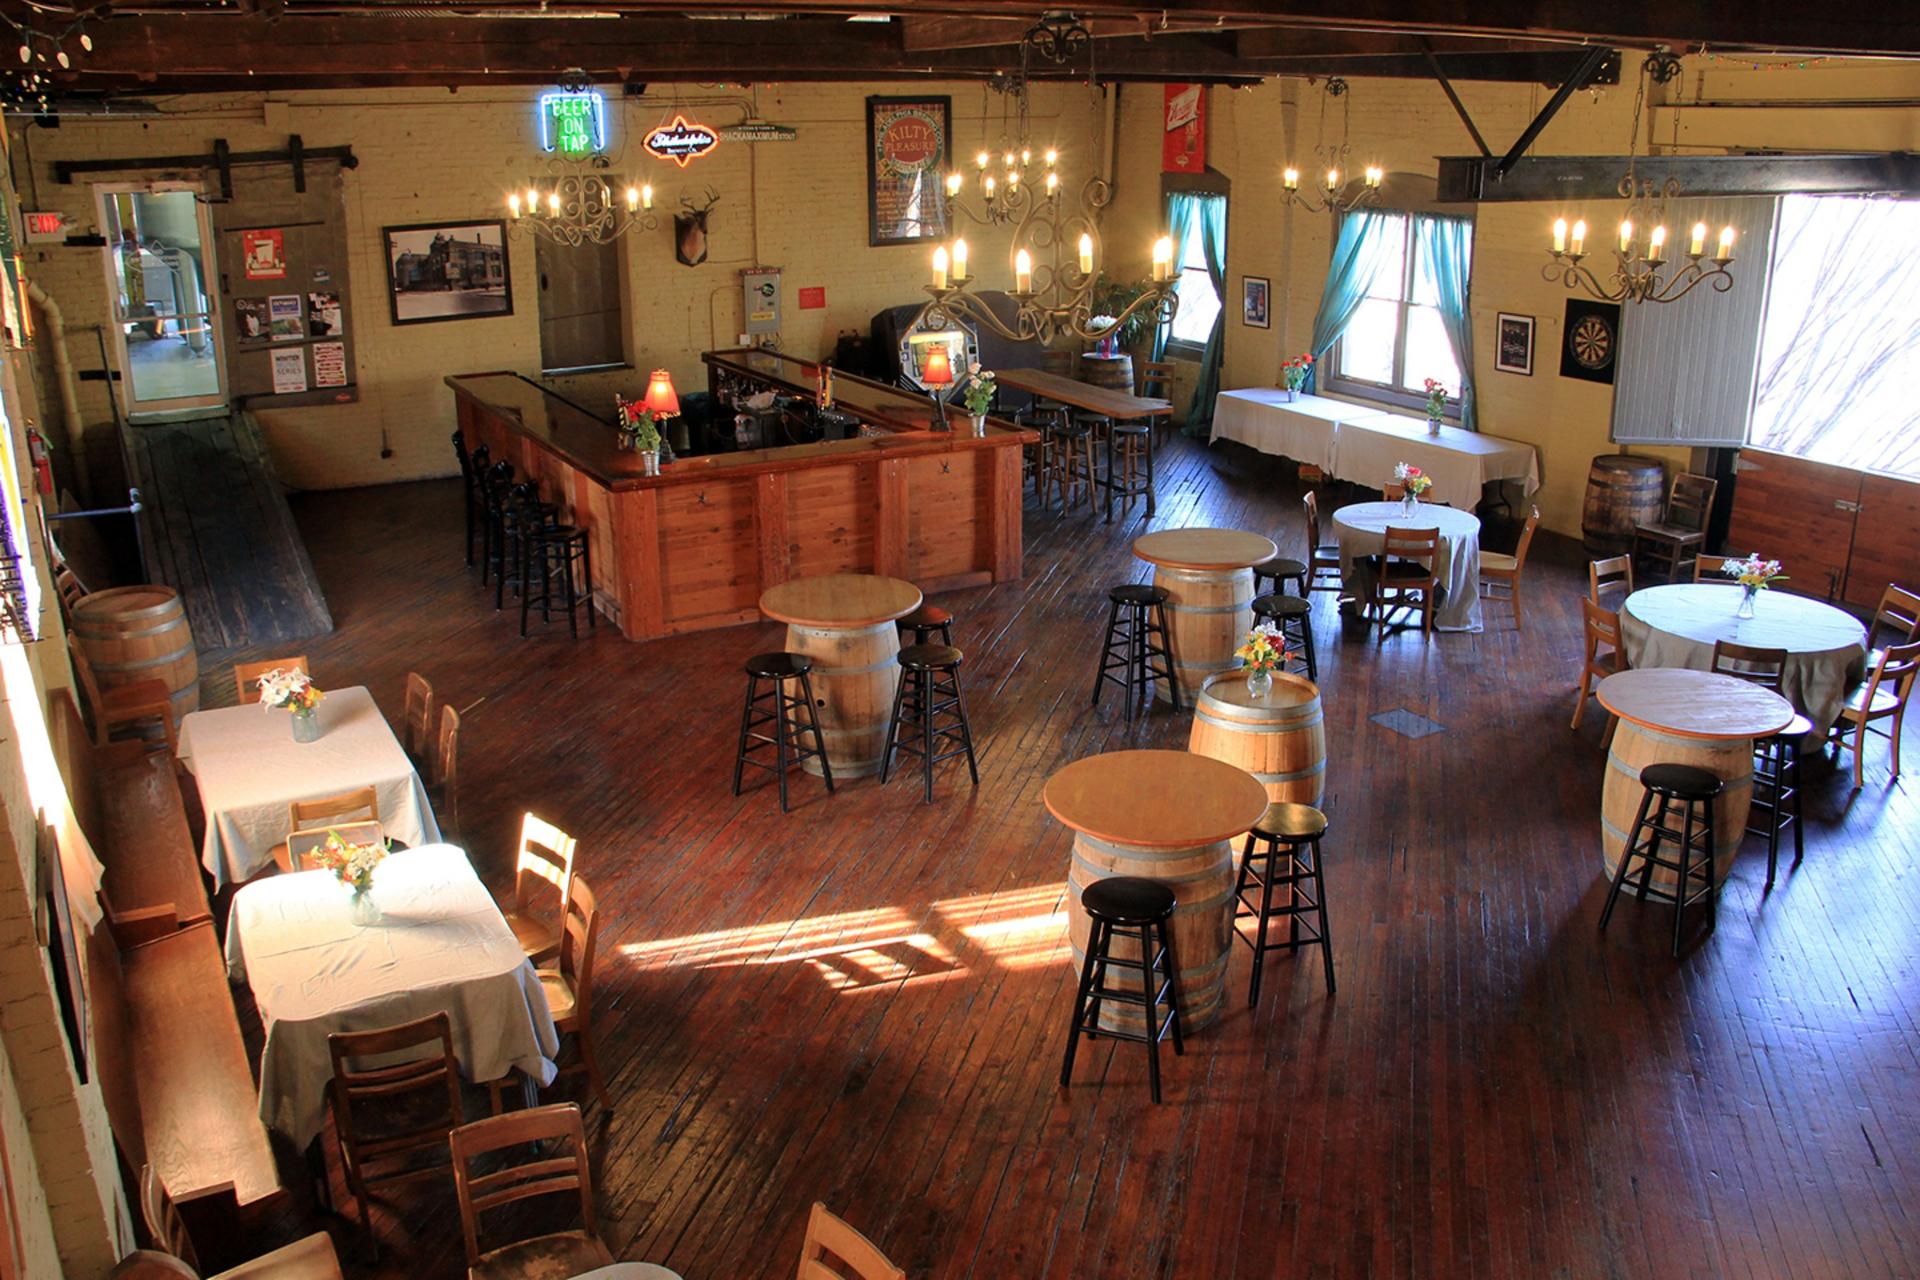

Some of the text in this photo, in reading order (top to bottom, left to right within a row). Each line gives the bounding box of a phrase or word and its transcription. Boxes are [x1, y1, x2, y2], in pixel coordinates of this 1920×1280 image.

[552, 98, 592, 117] BEER
[563, 117, 584, 135] ON
[888, 124, 933, 142] KILTY
[560, 134, 590, 152] TAP
[884, 141, 936, 153] PLEASURE
[28, 214, 57, 234] EXIT
